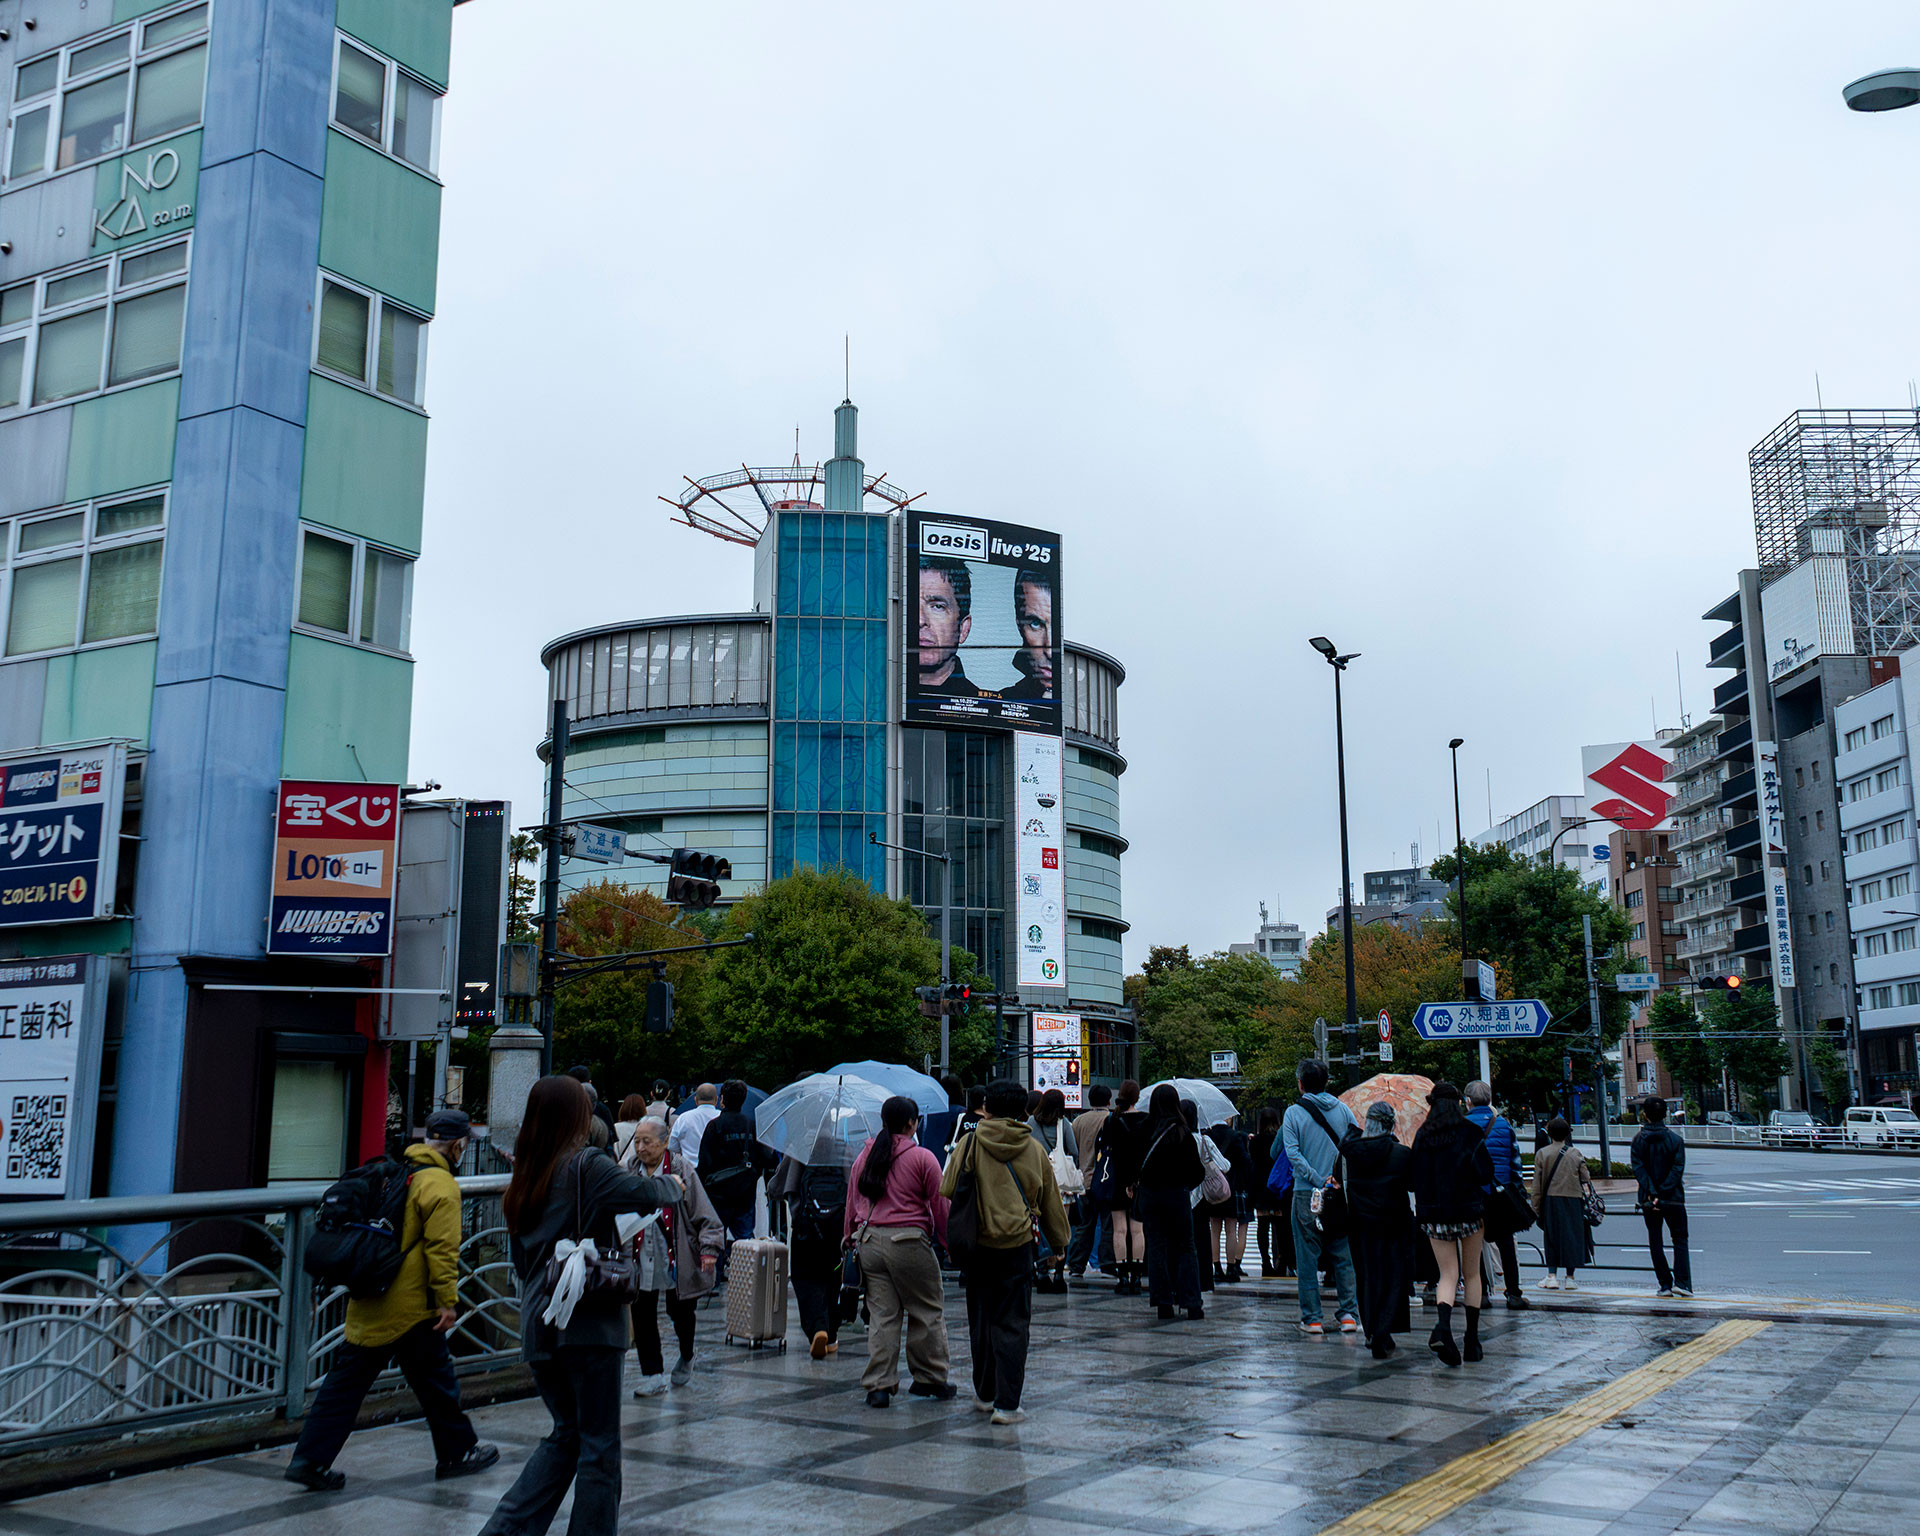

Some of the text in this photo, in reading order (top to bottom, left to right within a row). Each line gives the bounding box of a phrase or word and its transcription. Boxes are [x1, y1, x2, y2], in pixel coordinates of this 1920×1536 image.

[121, 148, 180, 201] NO
[927, 533, 982, 551] oasis
[991, 537, 1023, 558] live
[285, 793, 392, 828] 宝くじ
[1762, 769, 1779, 837] ホテル サトー
[582, 830, 621, 850] 水道橋
[286, 849, 342, 881] LOTO
[276, 909, 385, 935] NUMBERS
[1774, 885, 1792, 976] 佐藤産業株式会社
[1431, 1014, 1450, 1027] 405
[1459, 1005, 1528, 1021] 外堀通り
[1457, 1021, 1533, 1033] Sotobori-dori Ave.
